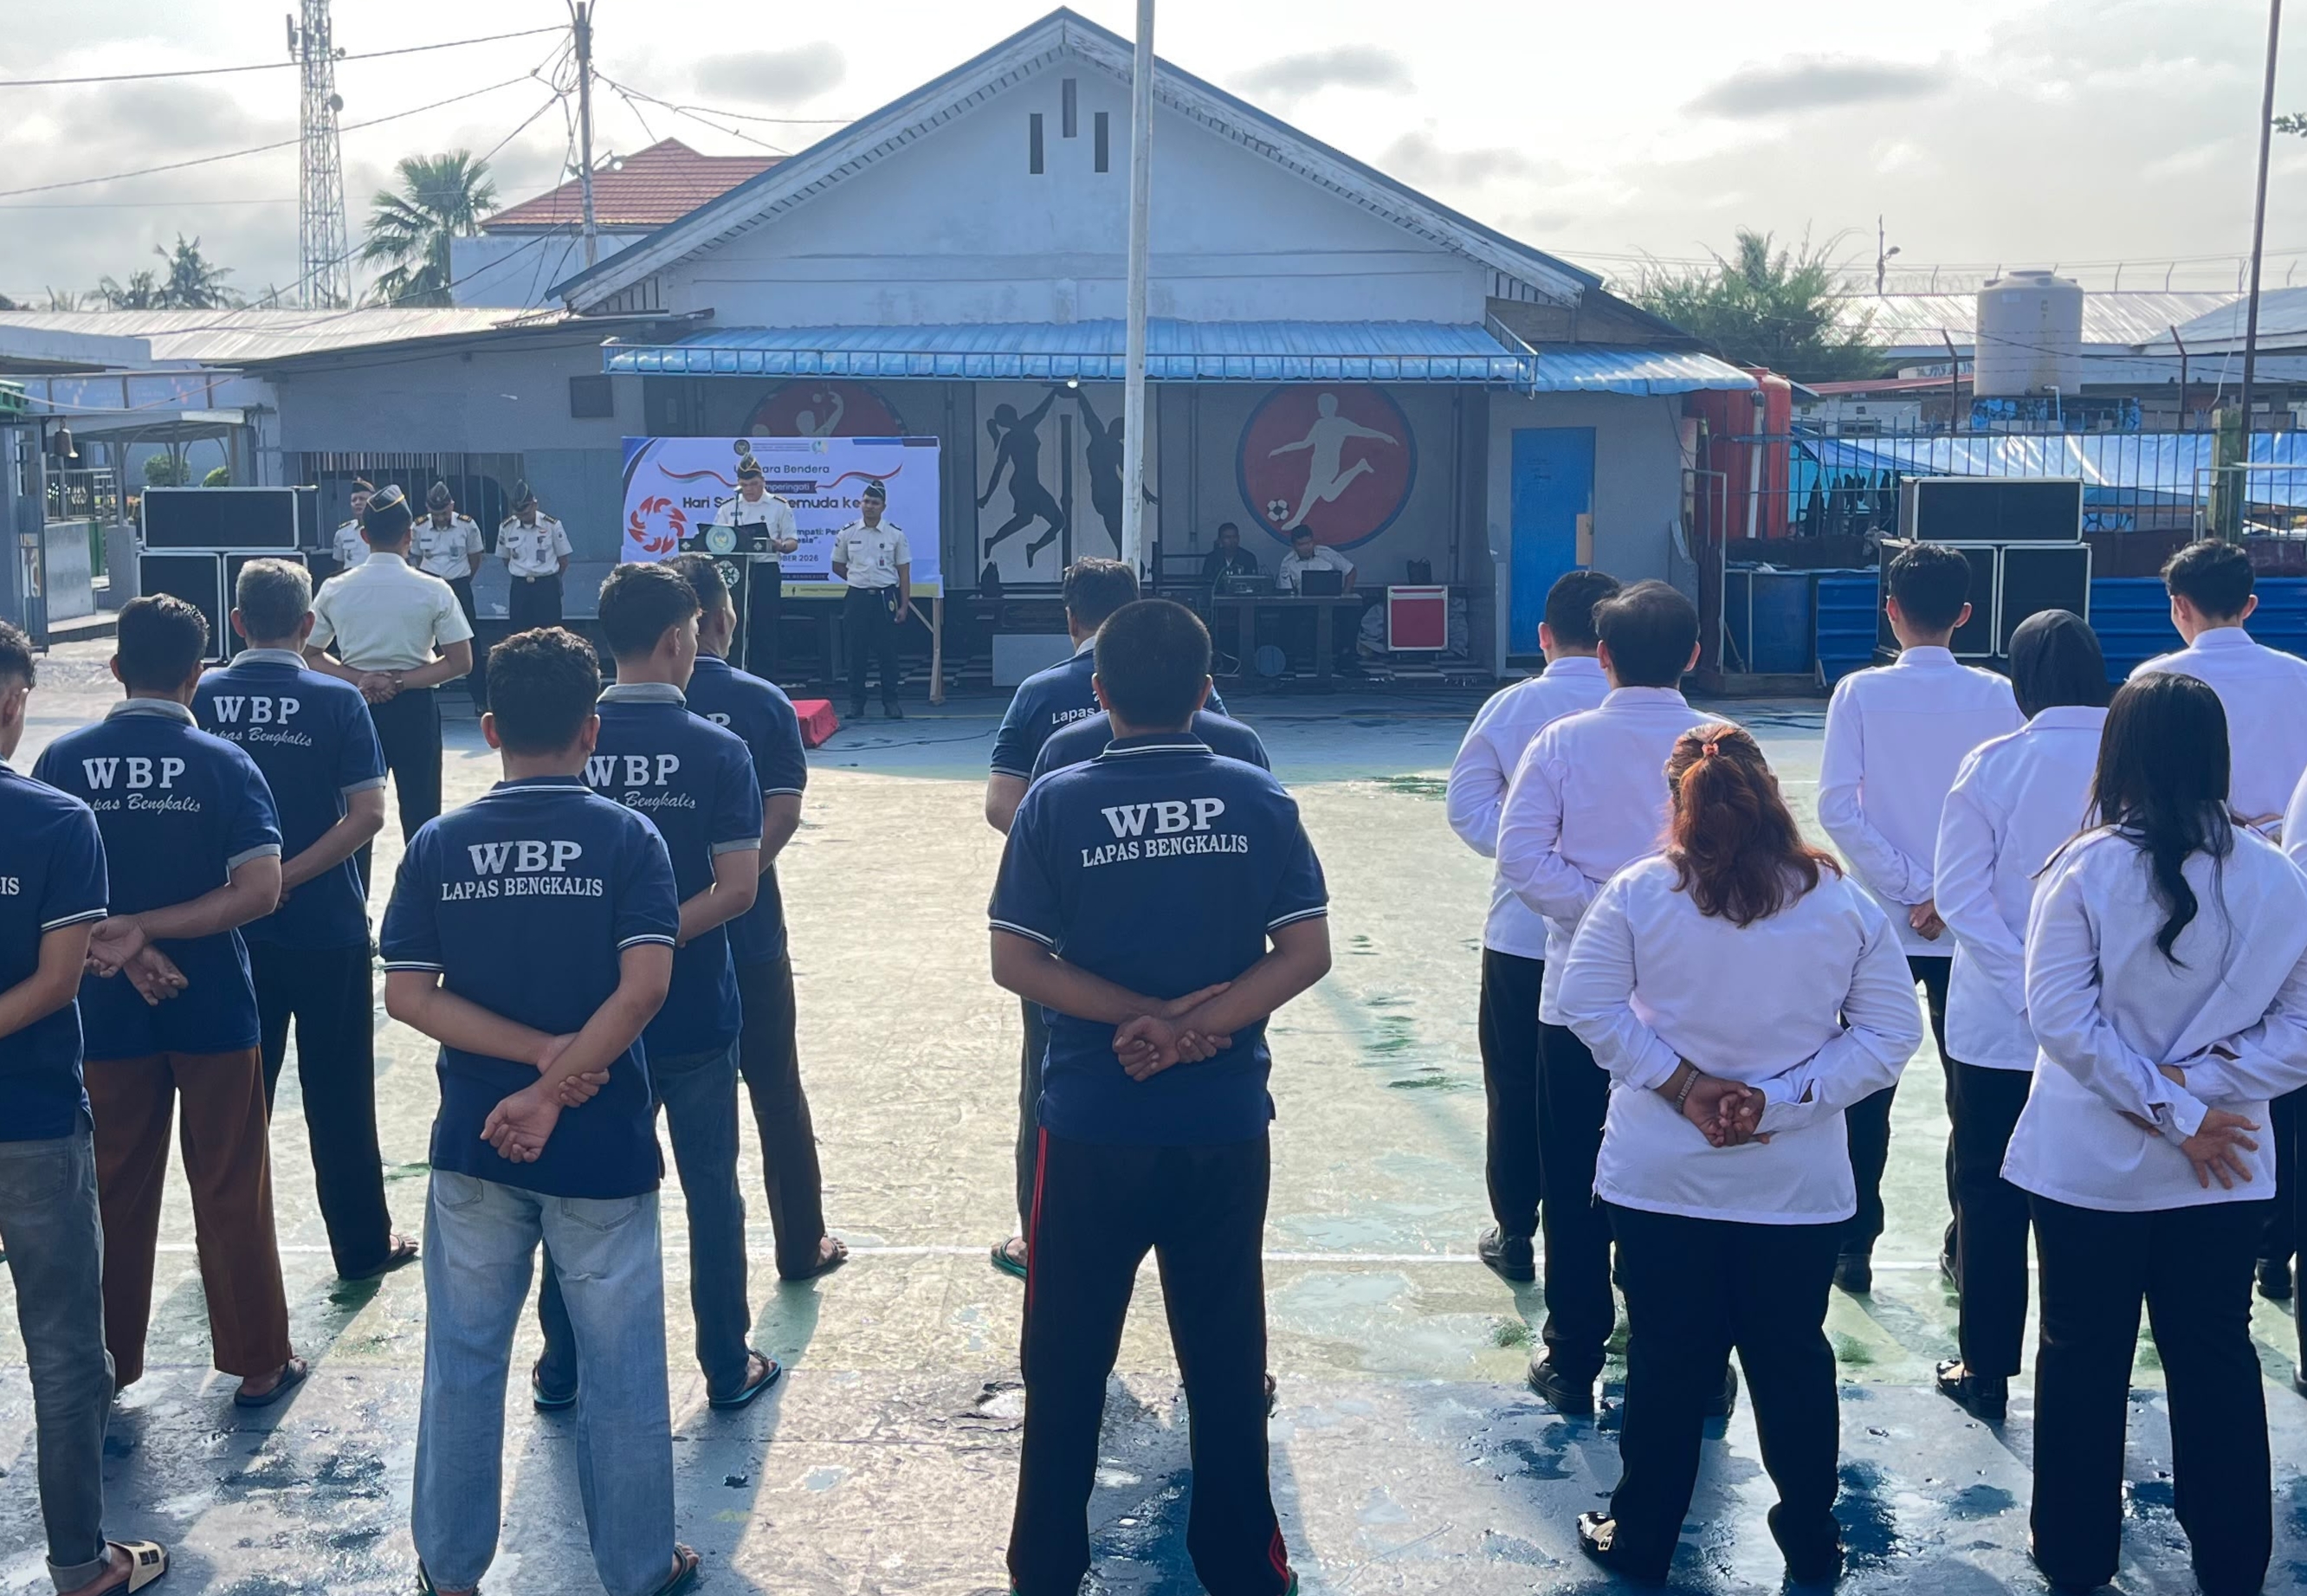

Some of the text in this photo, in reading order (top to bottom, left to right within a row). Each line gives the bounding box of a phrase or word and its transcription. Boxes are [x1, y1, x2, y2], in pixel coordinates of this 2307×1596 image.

[784, 464, 830, 474] Bendera
[682, 496, 710, 508] Hari
[789, 497, 838, 508] emuda
[213, 696, 300, 724] WBP
[1052, 708, 1095, 724] Lapas
[249, 727, 312, 746] Bengkalis
[83, 757, 185, 789] WBP
[585, 754, 680, 787] WBP
[126, 793, 201, 815] Bengkalis
[624, 791, 695, 812] Bengkalis
[1101, 798, 1225, 838] WBP
[468, 840, 583, 875] WBP
[1082, 834, 1249, 868] LAPAS BENGKALIS
[442, 876, 603, 901] LAPAS BENGKALIS
